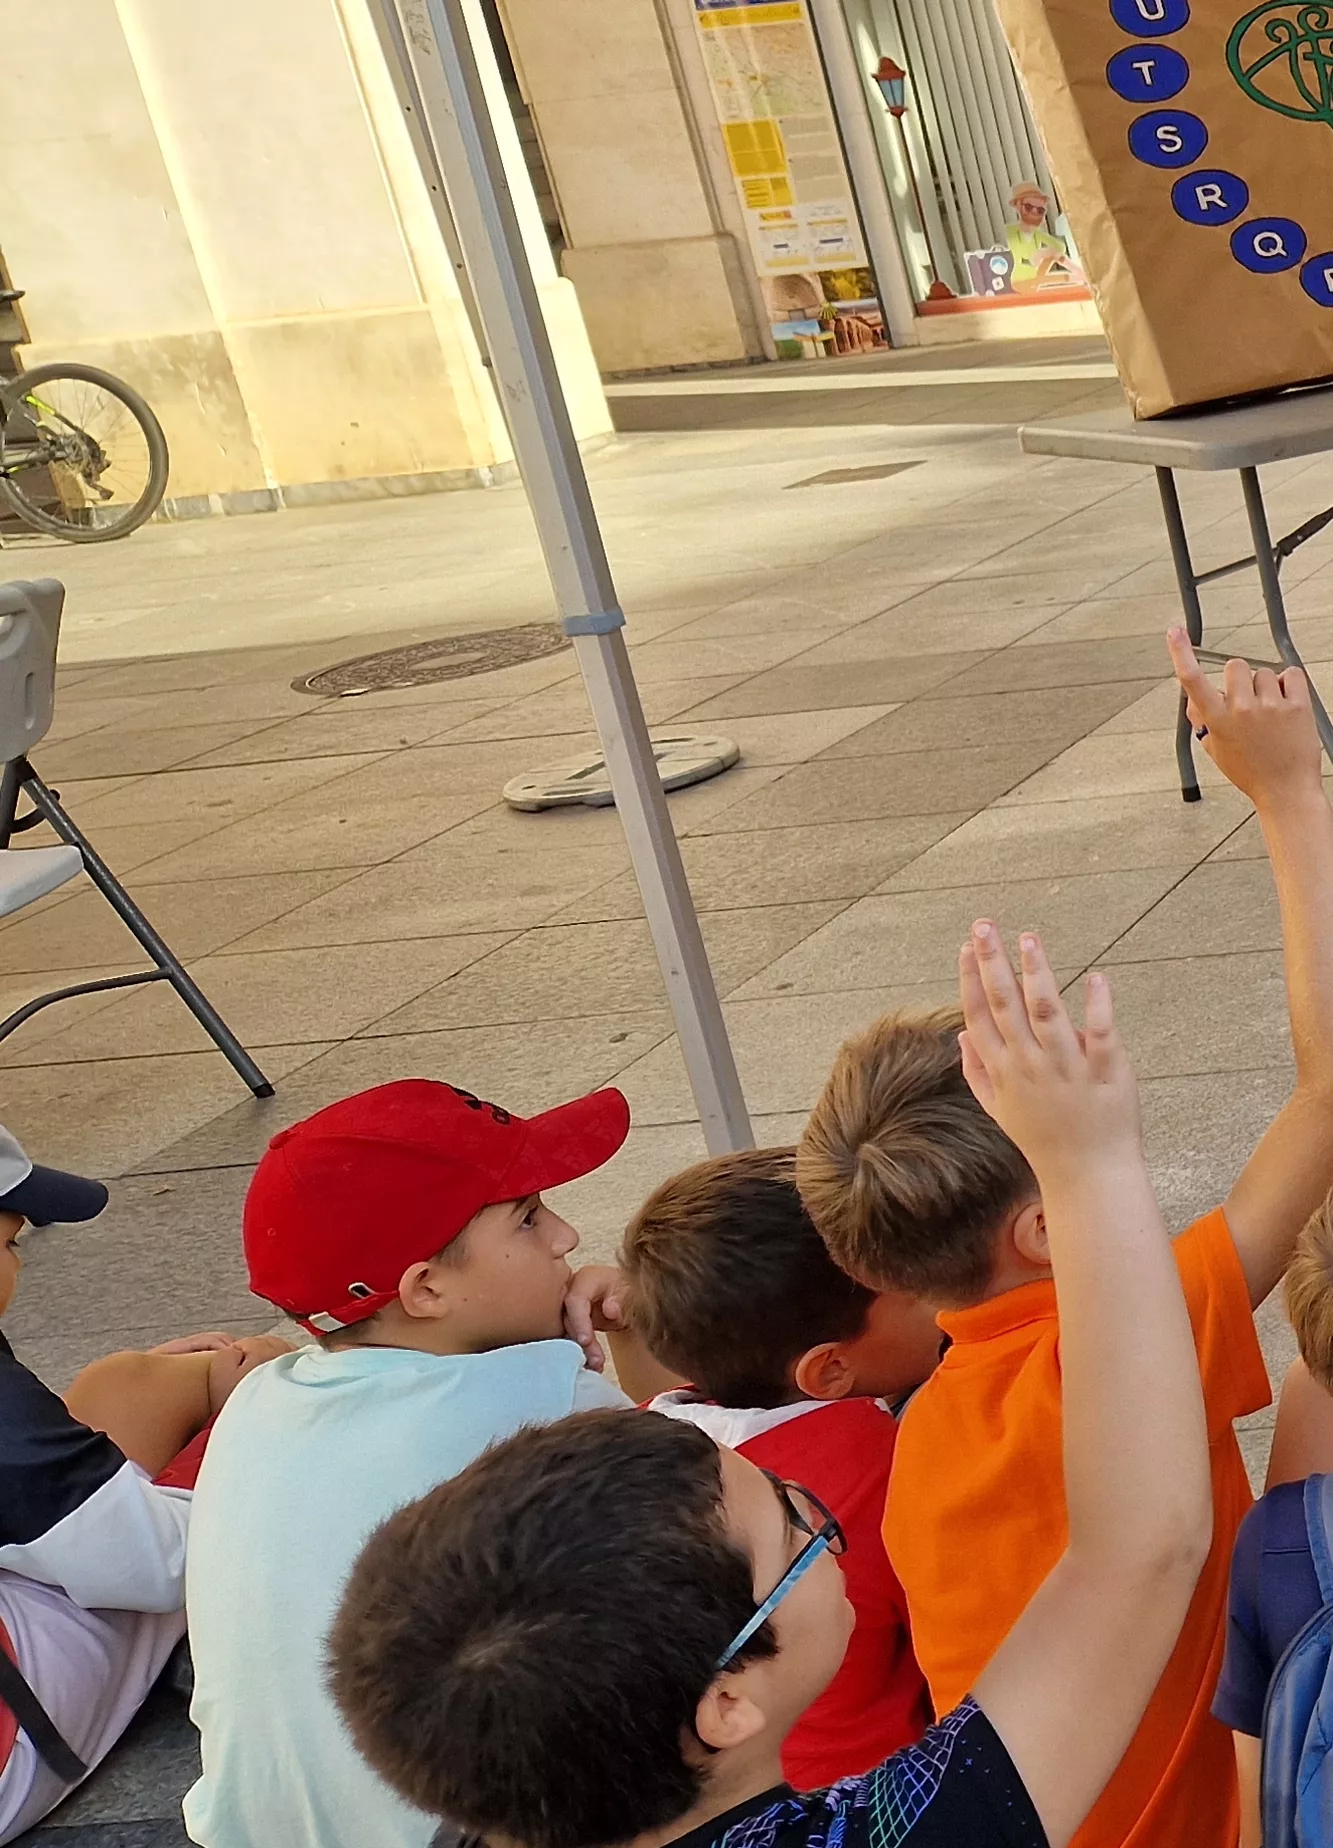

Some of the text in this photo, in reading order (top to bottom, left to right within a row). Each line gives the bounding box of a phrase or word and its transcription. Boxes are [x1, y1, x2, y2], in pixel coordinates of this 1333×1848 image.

[1134, 0, 1165, 21] U
[1132, 60, 1155, 86] T
[1156, 125, 1182, 153] S
[1194, 182, 1228, 212] R
[1253, 231, 1288, 258] Q
